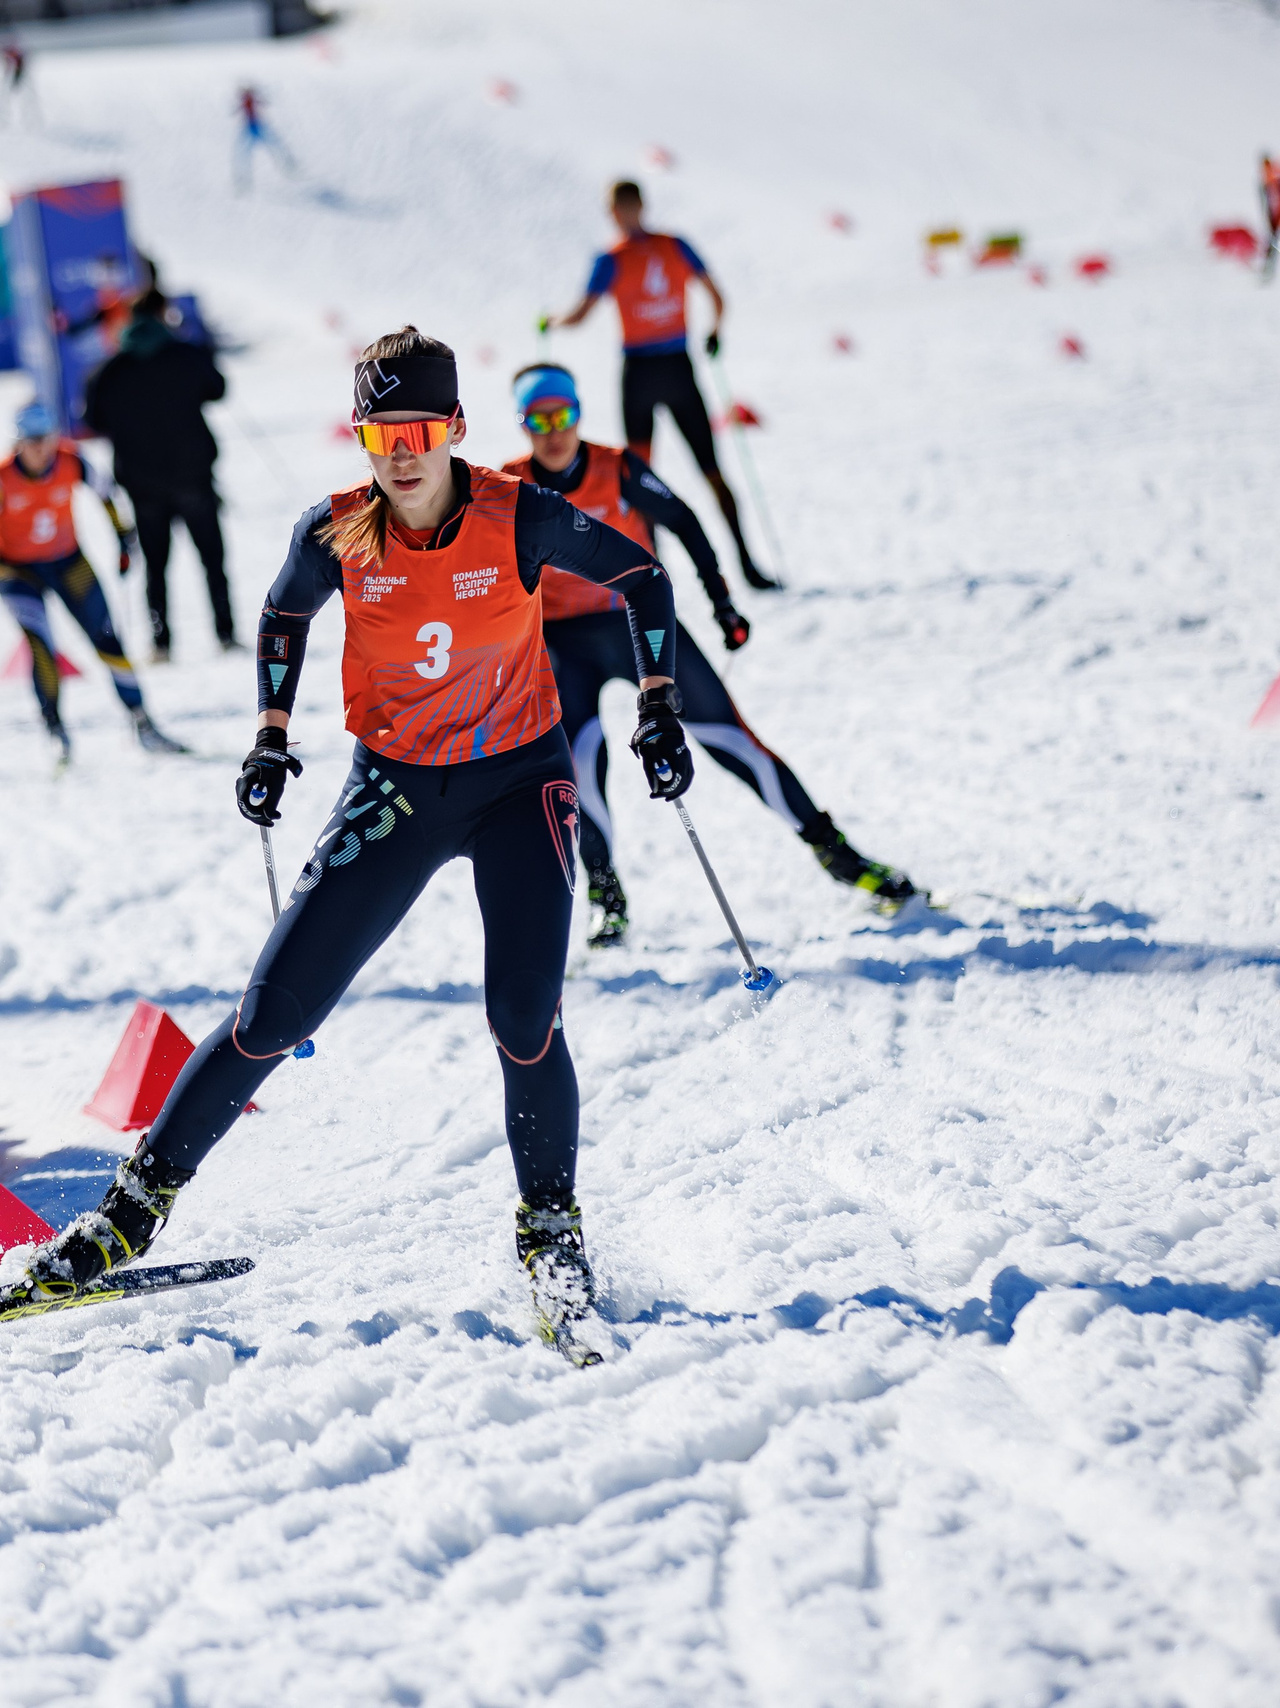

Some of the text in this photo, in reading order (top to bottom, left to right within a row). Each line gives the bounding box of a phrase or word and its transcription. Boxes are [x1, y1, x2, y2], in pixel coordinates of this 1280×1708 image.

[363, 576, 408, 585] ЛЫЖНЫЕ
[452, 567, 499, 583] КОМАНДА
[363, 585, 393, 594] ГОНКИ
[454, 576, 497, 592] ГАЗПРОМ
[362, 594, 381, 602] 2025
[455, 587, 488, 601] НЕФТИ
[413, 621, 453, 680] 3
